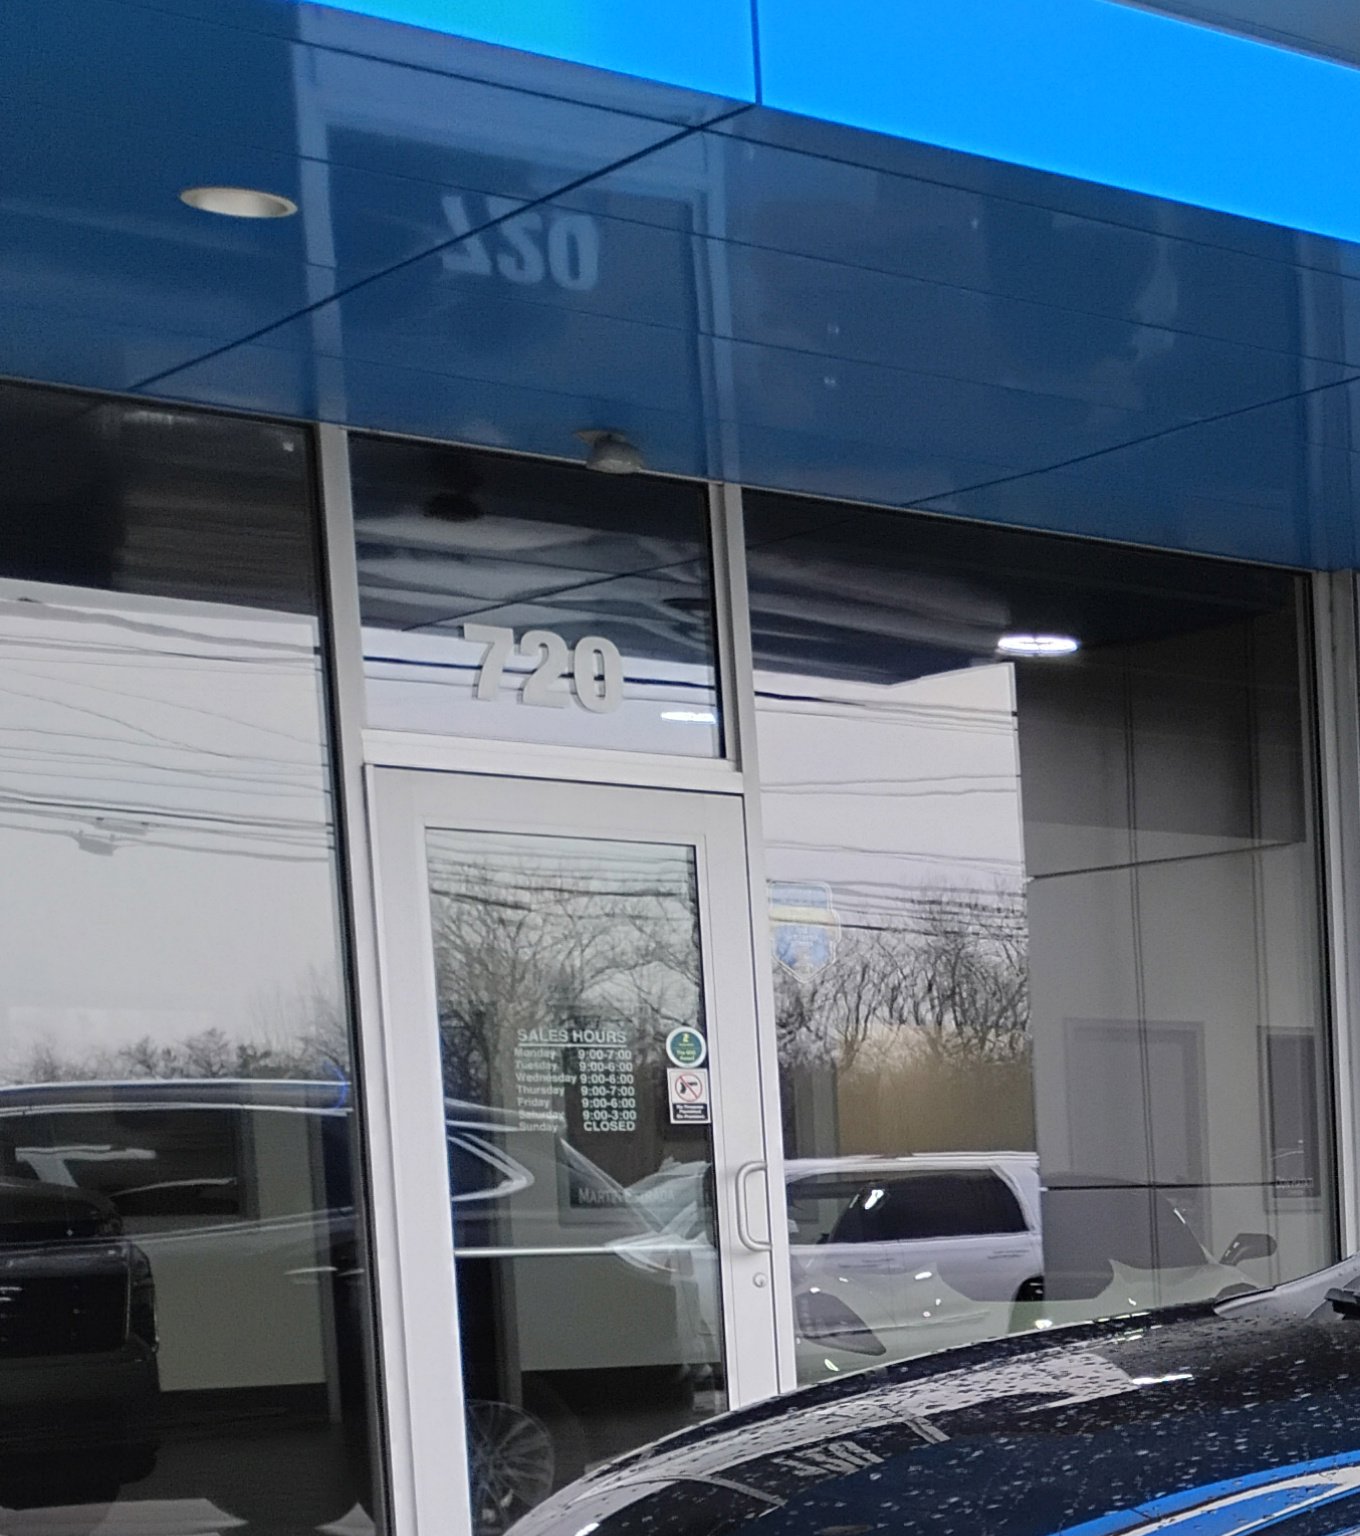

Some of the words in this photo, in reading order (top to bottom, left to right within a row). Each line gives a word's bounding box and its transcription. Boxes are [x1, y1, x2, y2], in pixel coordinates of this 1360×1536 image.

[463, 622, 624, 714] 720
[517, 1028, 569, 1042] SALES
[572, 1029, 627, 1043] HOURS
[514, 1047, 557, 1061] Monday
[578, 1049, 632, 1060] 9:00-7:00
[515, 1060, 558, 1072] Tuesday
[579, 1062, 633, 1072] 9:00-6:00
[515, 1072, 577, 1085] Wednesday
[580, 1074, 634, 1084] 9:00-6:00
[517, 1084, 565, 1097] Thursday
[581, 1086, 635, 1096] 9:00-7:00
[517, 1097, 551, 1109] Friday
[582, 1098, 636, 1108] 9:00-6:00
[582, 1110, 637, 1120] 9:00-3:00
[518, 1121, 559, 1133] Sunday
[583, 1121, 636, 1131] CLOSED
